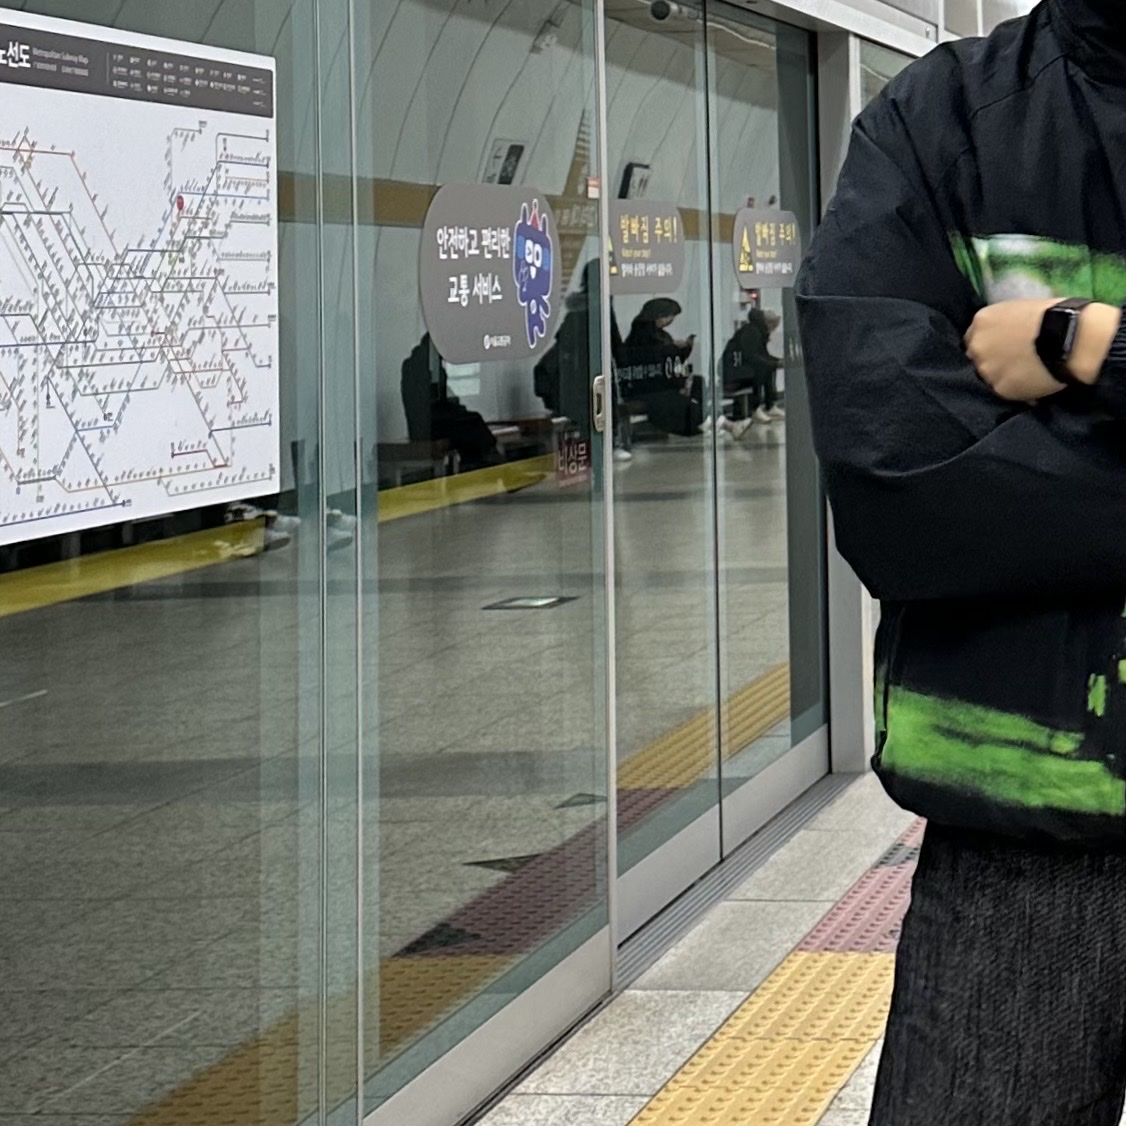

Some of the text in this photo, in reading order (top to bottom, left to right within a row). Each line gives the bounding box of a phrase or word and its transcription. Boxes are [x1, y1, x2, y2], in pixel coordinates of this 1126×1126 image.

[436, 226, 511, 260] 안전하고 편리한
[620, 214, 649, 244] 발빠짐
[654, 216, 678, 244] 주의!
[448, 273, 503, 307] 교통 서비스
[558, 443, 588, 475] 비상문
